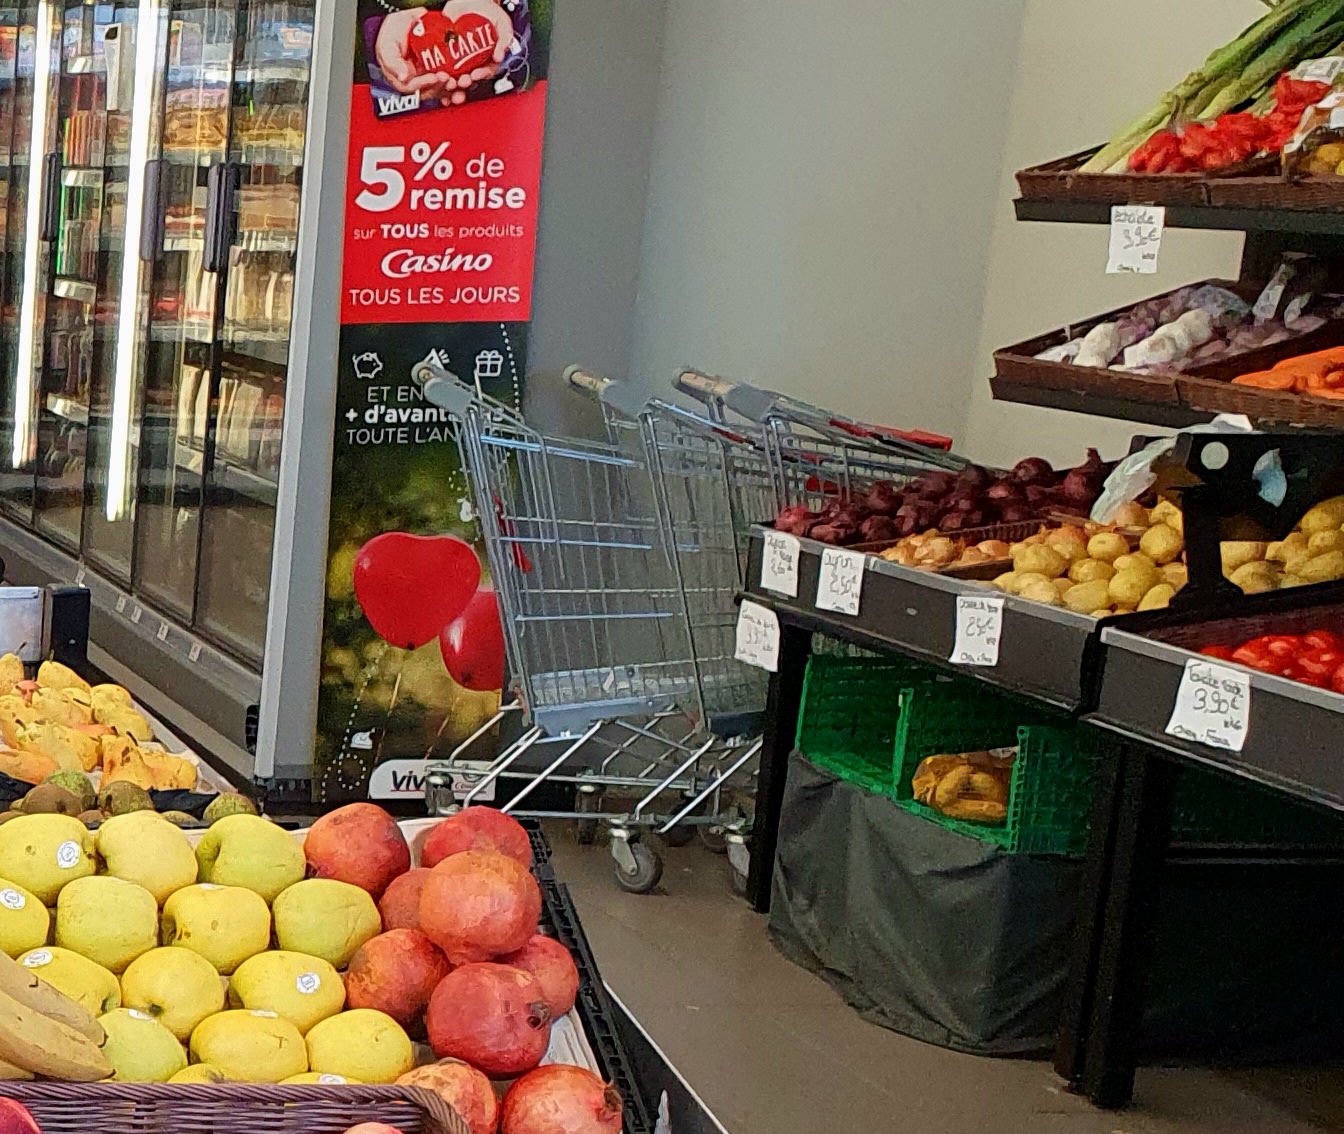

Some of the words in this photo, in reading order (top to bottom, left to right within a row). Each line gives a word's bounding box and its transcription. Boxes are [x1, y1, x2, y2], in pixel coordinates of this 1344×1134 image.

[421, 45, 446, 71] MA
[447, 23, 495, 60] CARTE
[355, 141, 453, 212] 5%
[466, 152, 505, 178] de
[410, 181, 526, 210] remise
[353, 228, 375, 240] sur
[380, 223, 430, 239] TOUS
[434, 224, 454, 237] les
[458, 223, 524, 240] produits
[380, 247, 493, 278] Casino
[349, 288, 401, 306] TOUS
[407, 287, 444, 304] LES
[450, 286, 521, 304] JOURS
[367, 386, 391, 403] ET
[346, 428, 409, 445] TOUTE
